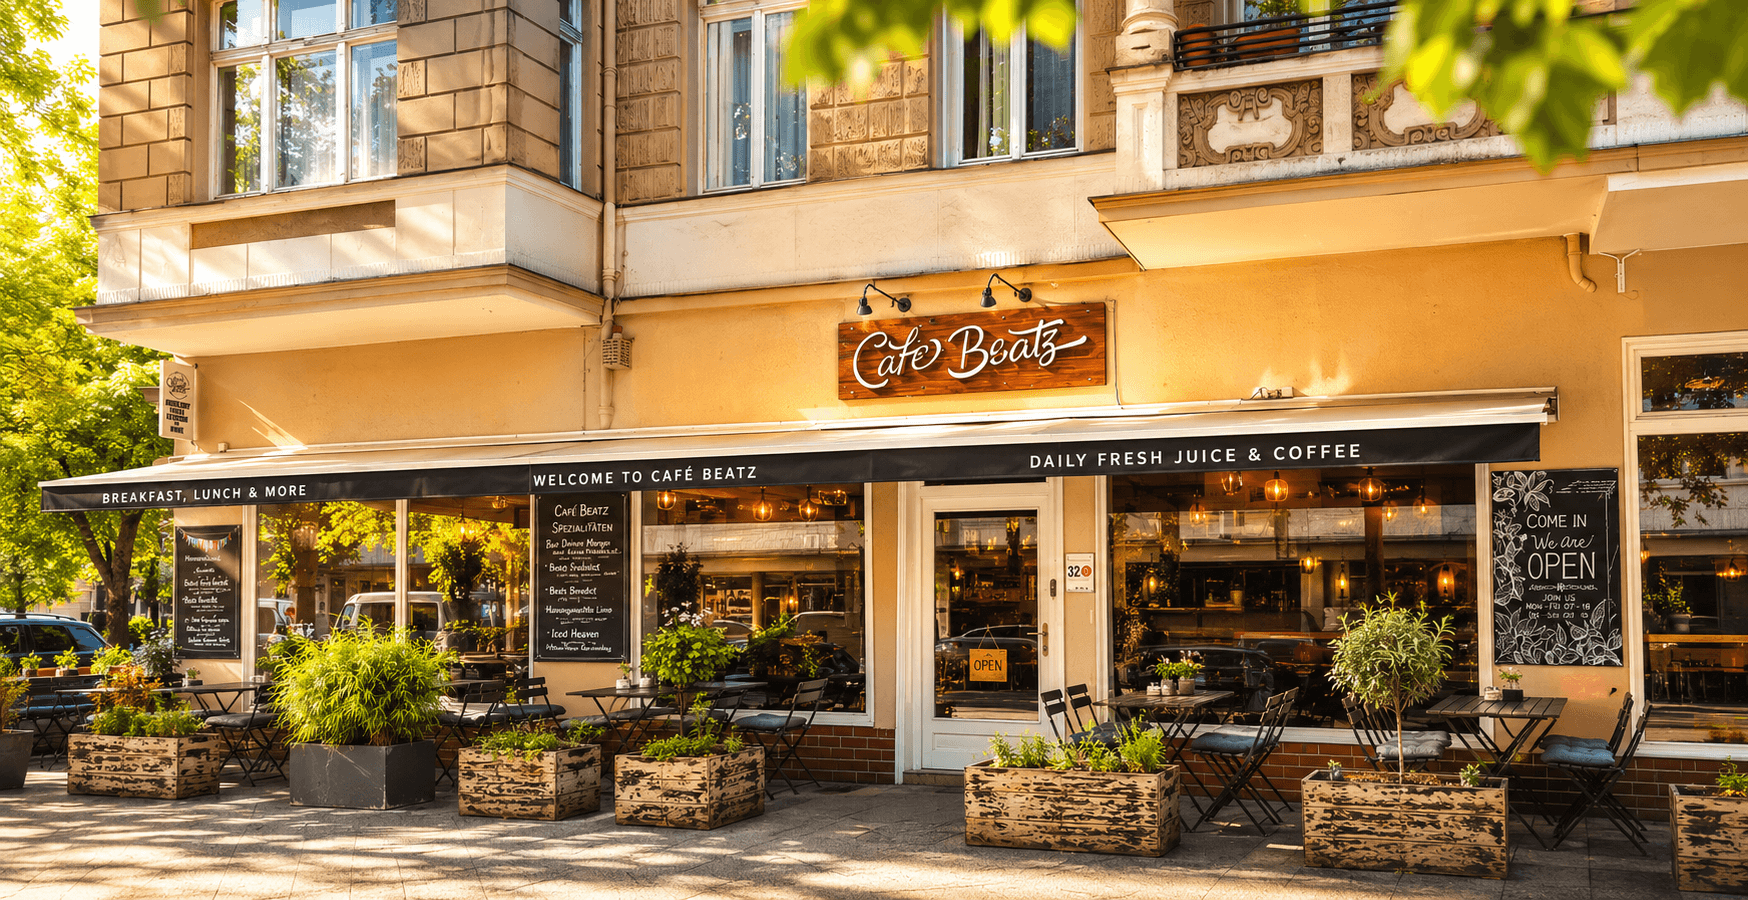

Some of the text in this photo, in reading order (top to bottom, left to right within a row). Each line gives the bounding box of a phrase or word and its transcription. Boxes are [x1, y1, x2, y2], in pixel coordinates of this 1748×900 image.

[947, 318, 1087, 379] Beatz
[1030, 443, 1361, 468] DAILY FRESH JUICE & COFFEE
[533, 466, 757, 487] WELCOME TO CAFÉ BEATZ
[102, 484, 307, 504] BREAKFAST, LUNCH & MORE
[1526, 513, 1587, 529] COME IN
[1530, 531, 1559, 550] We
[1067, 565, 1081, 578] 32
[1527, 551, 1596, 580] OPEN
[1542, 593, 1576, 602] JOIN US
[973, 659, 1002, 672] OPEN
